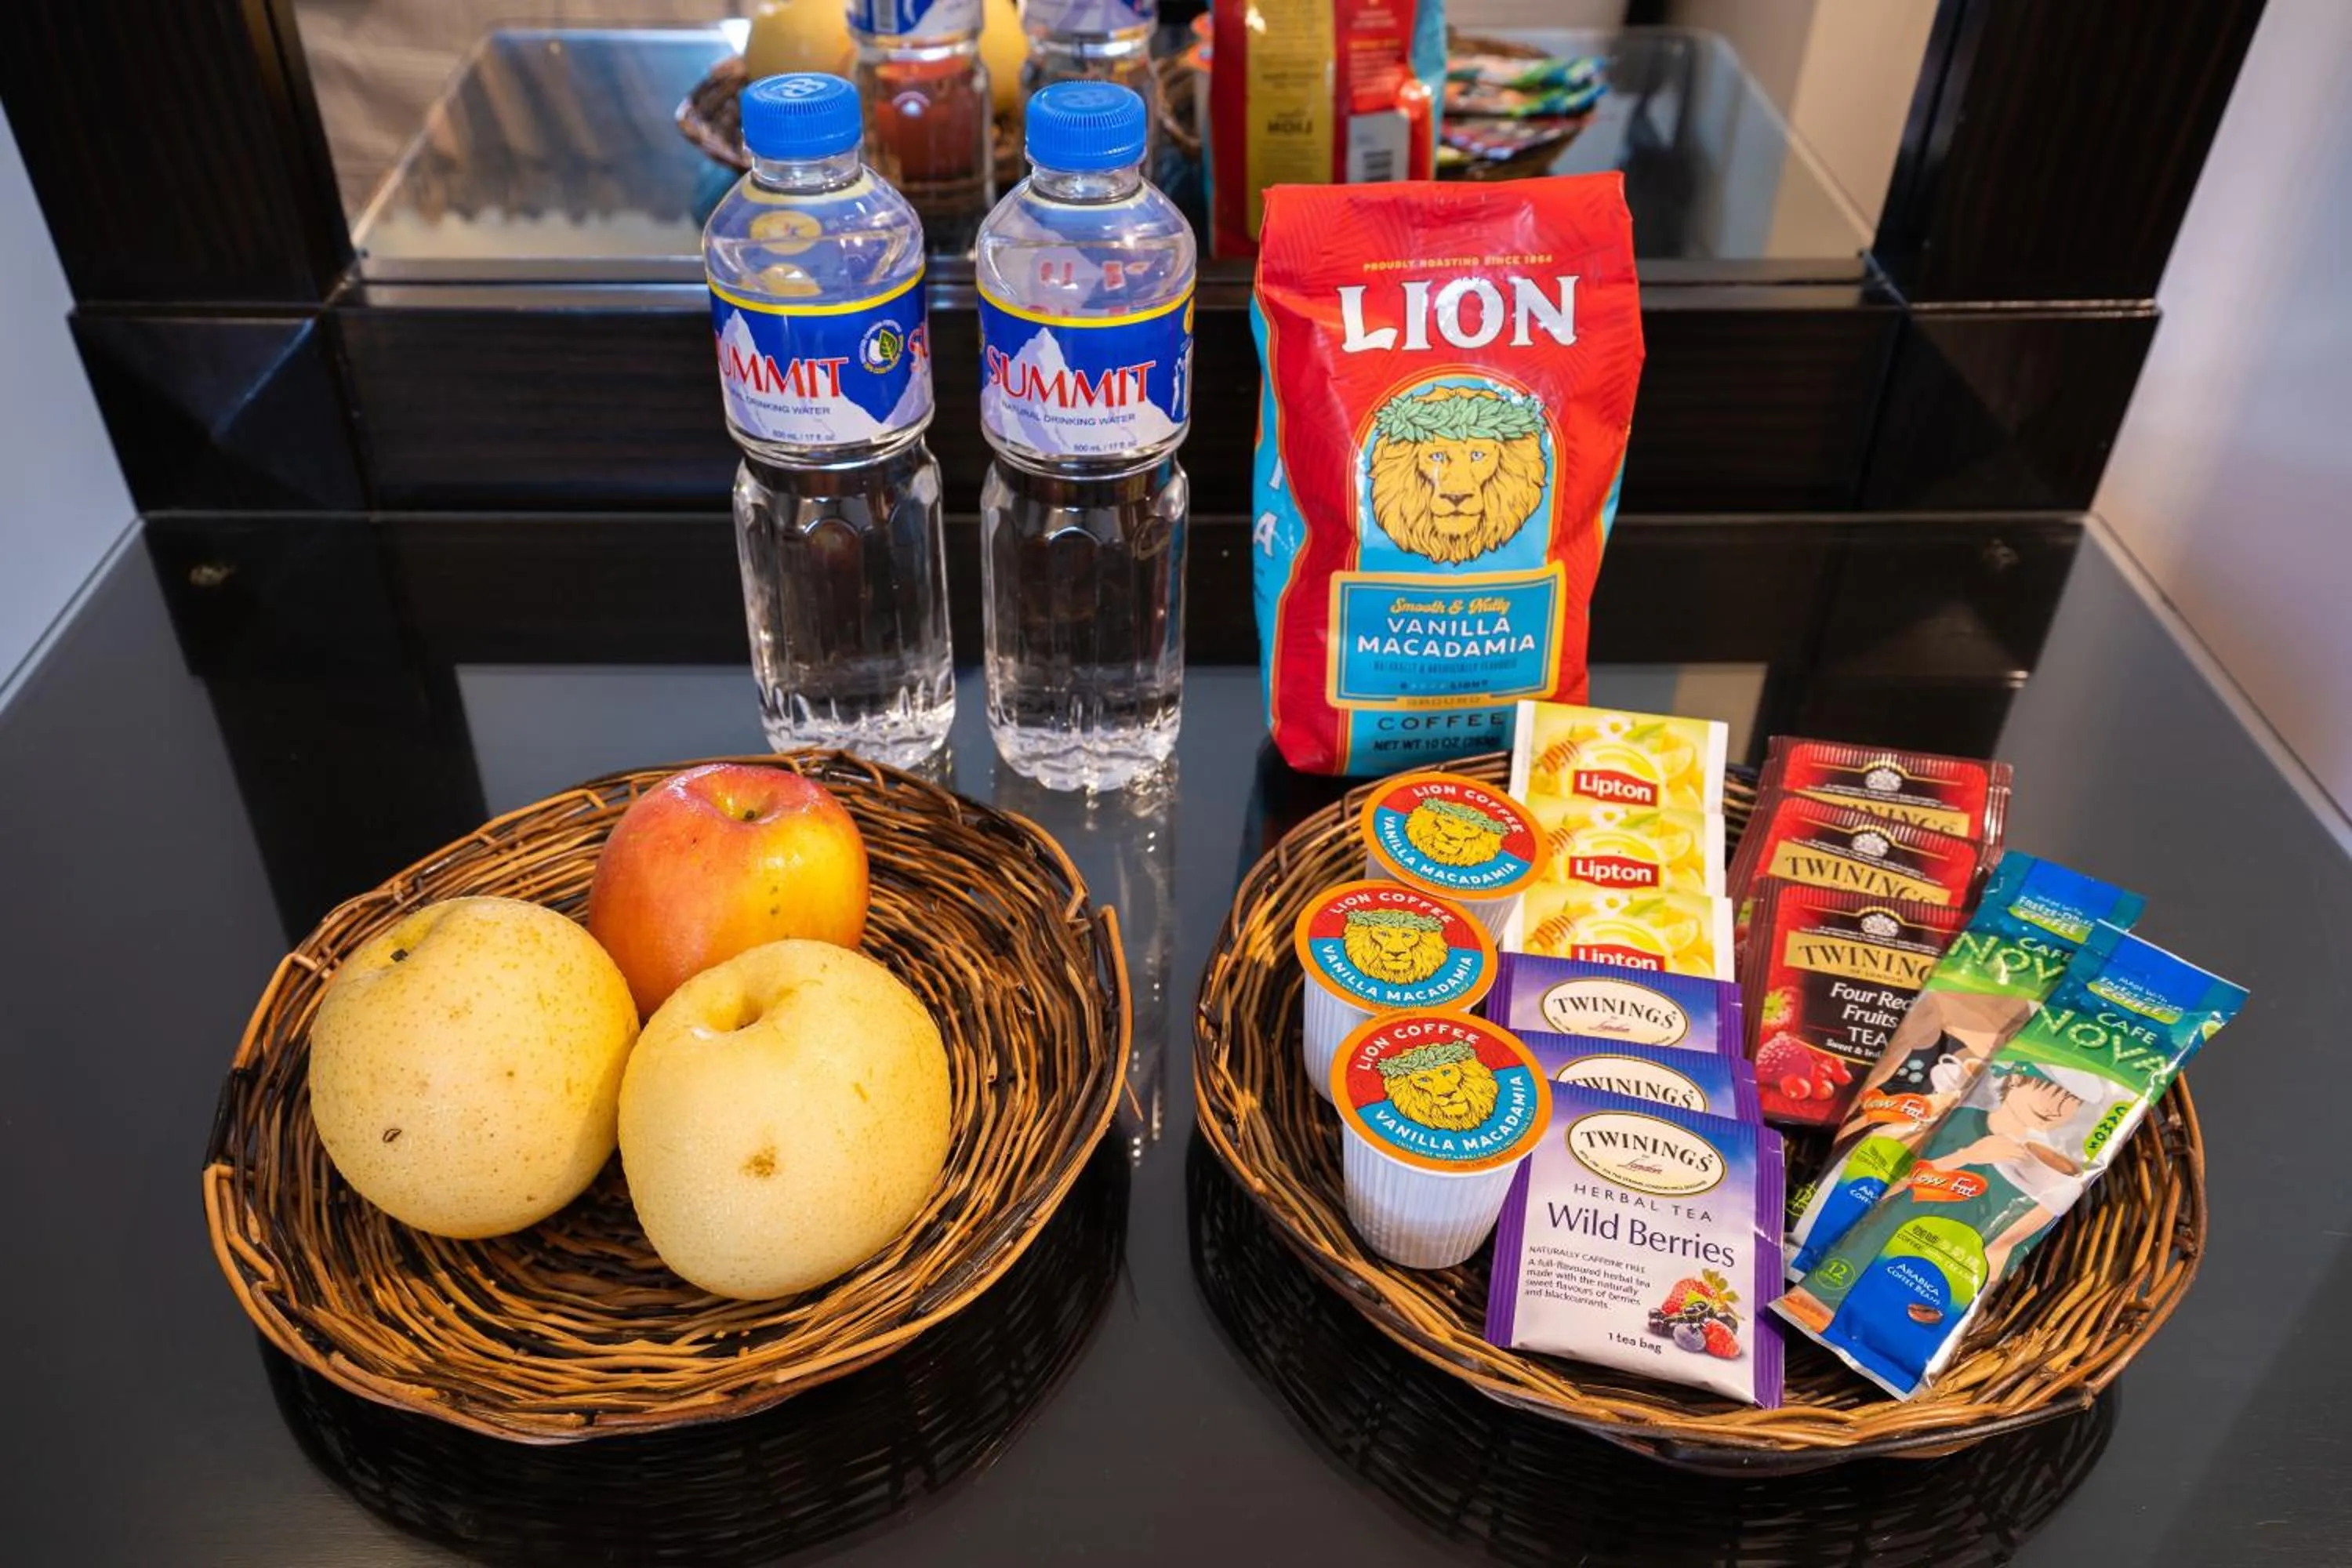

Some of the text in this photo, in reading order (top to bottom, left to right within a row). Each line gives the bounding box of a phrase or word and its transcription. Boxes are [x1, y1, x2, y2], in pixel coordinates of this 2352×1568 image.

[1363, 255, 1553, 272] PROUDLY ROASTING SINCE 1864
[1337, 275, 1580, 354] LION
[715, 329, 849, 398] UMMIT
[987, 344, 1156, 408] SUMMIT
[746, 395, 789, 414] DRINKING
[1001, 399, 1135, 426] NATURAL DRINKING WATER
[1390, 597, 1511, 615] Smooth & Nutty
[1387, 617, 1511, 637] VANILLA
[1357, 633, 1535, 658] MACADAMIA
[1377, 712, 1505, 731] COFFEE
[1374, 739, 1399, 751] NET
[1402, 739, 1421, 750] WT
[1425, 739, 1439, 749] 10
[1443, 737, 1461, 749] OZ
[1580, 773, 1651, 803] Lipton
[1413, 785, 1525, 833] LION COFFEE
[1384, 815, 1416, 866] VANILLA
[1420, 862, 1517, 885] MACADAMIA
[1575, 860, 1652, 882] Lipton
[1785, 856, 1937, 903] TWINING
[1330, 892, 1455, 924] LION COFFEE
[1798, 944, 1932, 983] TWININ
[1948, 931, 2066, 980] NOV
[1323, 945, 1379, 998] VANILLA
[1386, 956, 1473, 1001] MACADAMIA
[1830, 982, 1878, 1004] Four
[1553, 996, 1678, 1029] TWININGS
[1842, 1004, 1899, 1029] Fruits
[1847, 1026, 1888, 1047] TEA
[2096, 1013, 2158, 1045] CAFE
[1356, 1022, 1481, 1071] LION COFFEE
[1825, 1038, 1853, 1053] Sweet
[1854, 1047, 1863, 1055] &
[2038, 1004, 2168, 1085] NOVA
[1568, 1076, 1694, 1110] WININGS
[1375, 1110, 1455, 1151] VANILLA
[1462, 1076, 1527, 1151] MACADAMIA
[1580, 1130, 1715, 1174] TWININGS
[1849, 1189, 1873, 1206] COFF
[1913, 1167, 1980, 1198] Low Fat
[1573, 1183, 1712, 1222] HERBAL TEA
[1547, 1201, 1736, 1269] Wild Berries
[1530, 1246, 1646, 1274] NATURALLY CAFFEINE FREE
[1537, 1258, 1601, 1276] full-flavoured
[1603, 1269, 1632, 1283] herbal
[1635, 1278, 1650, 1288] tea
[1526, 1268, 1639, 1296] made with the naturally
[1526, 1279, 1641, 1305] sweet flavours of berries
[1887, 1266, 1915, 1288] COFFEE
[1897, 1263, 1939, 1296] ARABICA
[1525, 1288, 1612, 1310] and blackcurrants.
[1608, 1332, 1663, 1356] 1 tea bag
